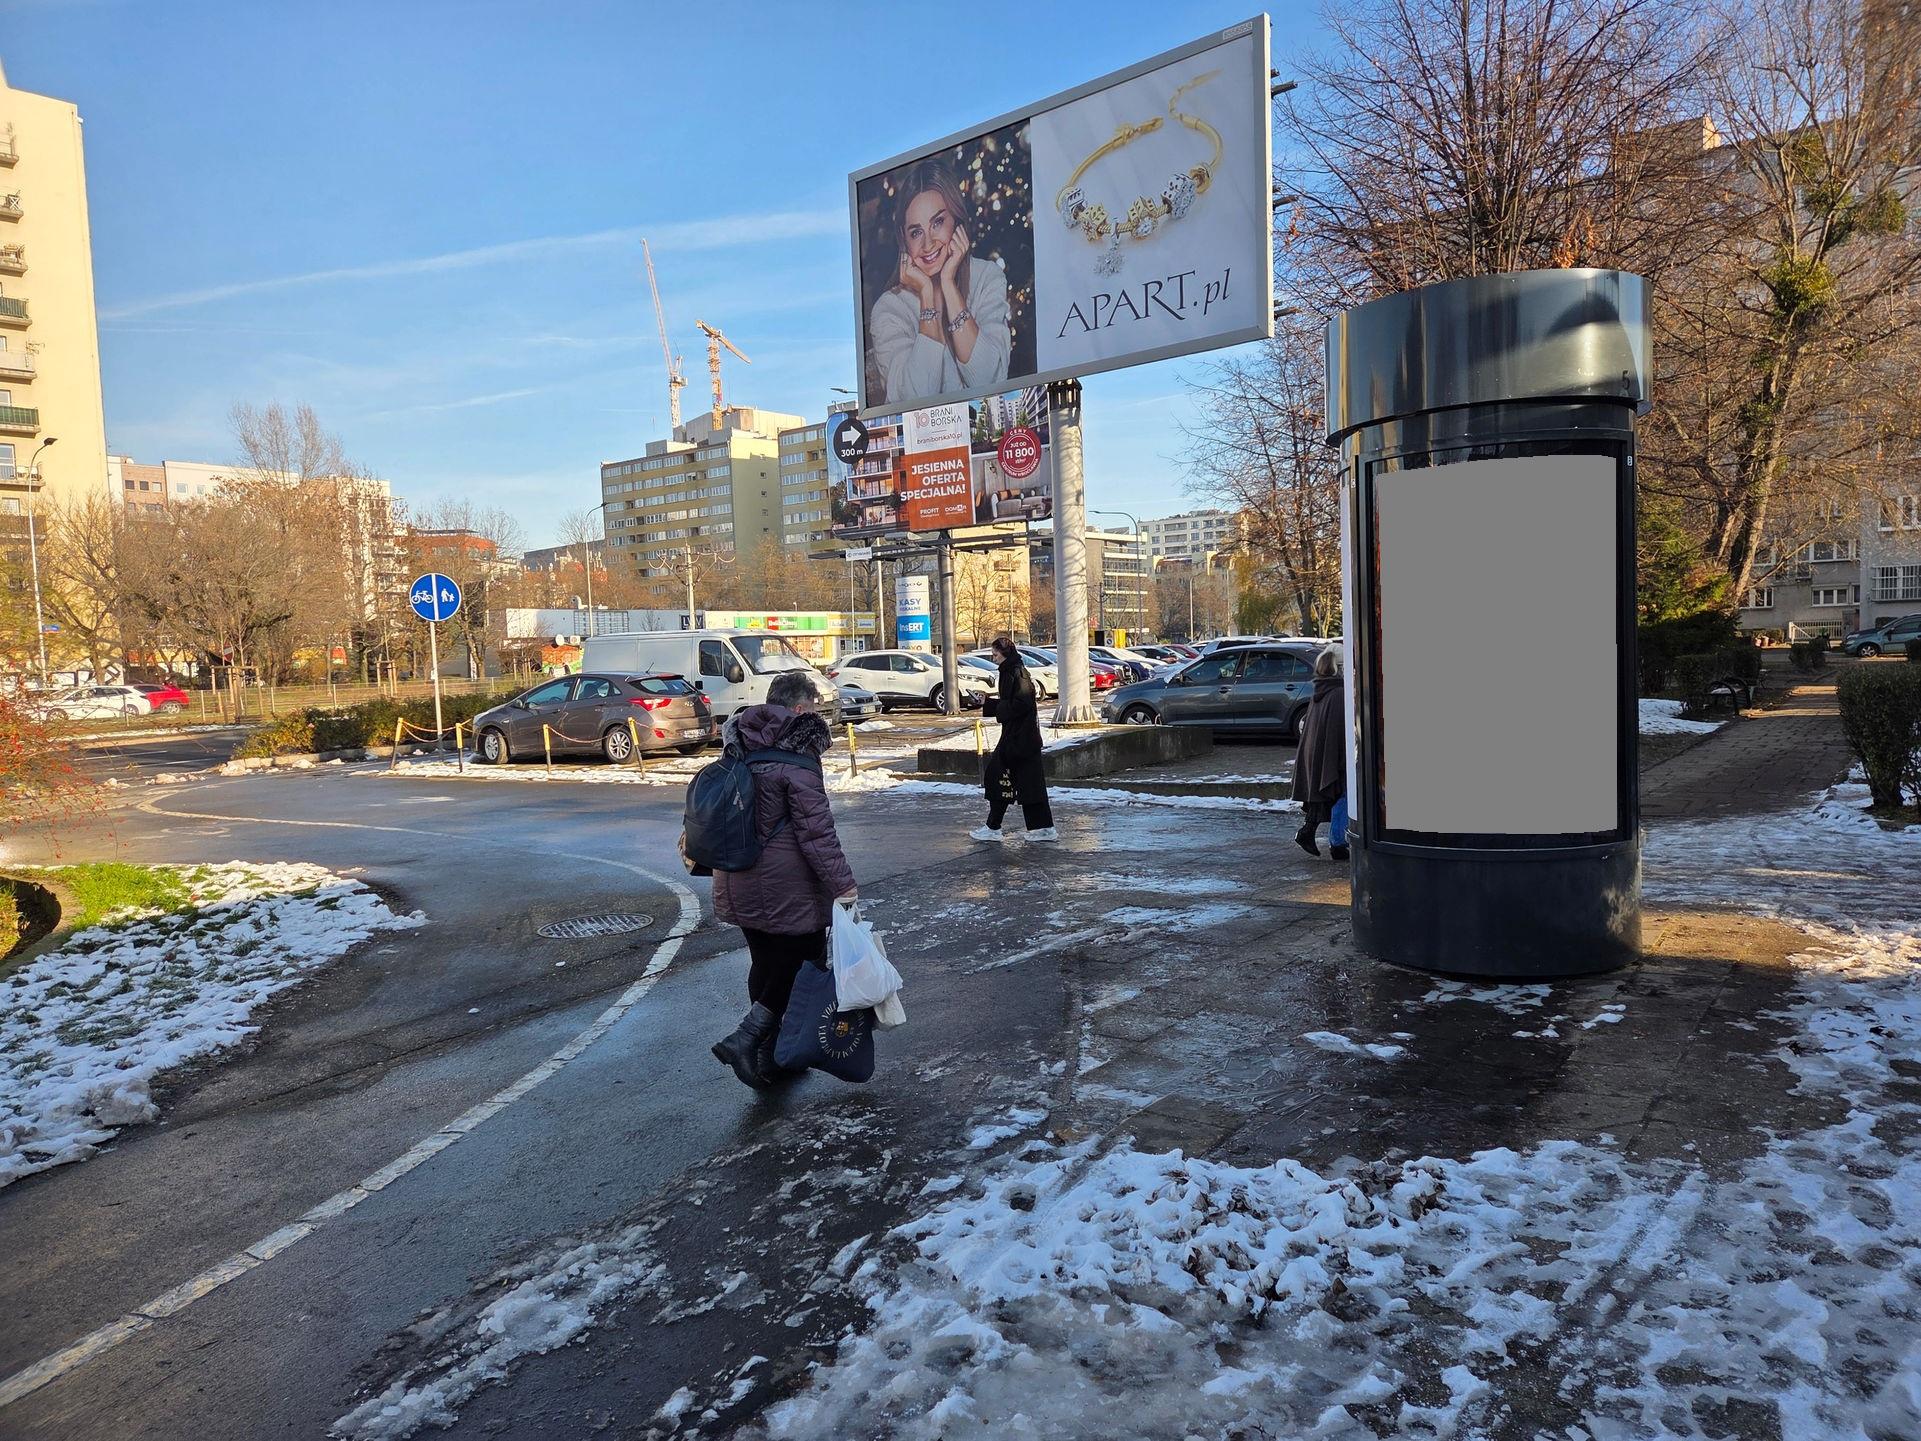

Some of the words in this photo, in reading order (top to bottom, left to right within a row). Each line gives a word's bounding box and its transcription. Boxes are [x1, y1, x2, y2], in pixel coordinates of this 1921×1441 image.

[1055, 267, 1231, 339] APART.pl
[930, 407, 953, 418] BRANI
[930, 416, 962, 427] BORSKA
[841, 448, 856, 458] 300
[1005, 449, 1013, 459] 11
[1014, 446, 1035, 458] 800
[911, 458, 965, 475] JESIENNA
[922, 471, 965, 486] OFERTA
[900, 483, 966, 502] SPECJALNA!
